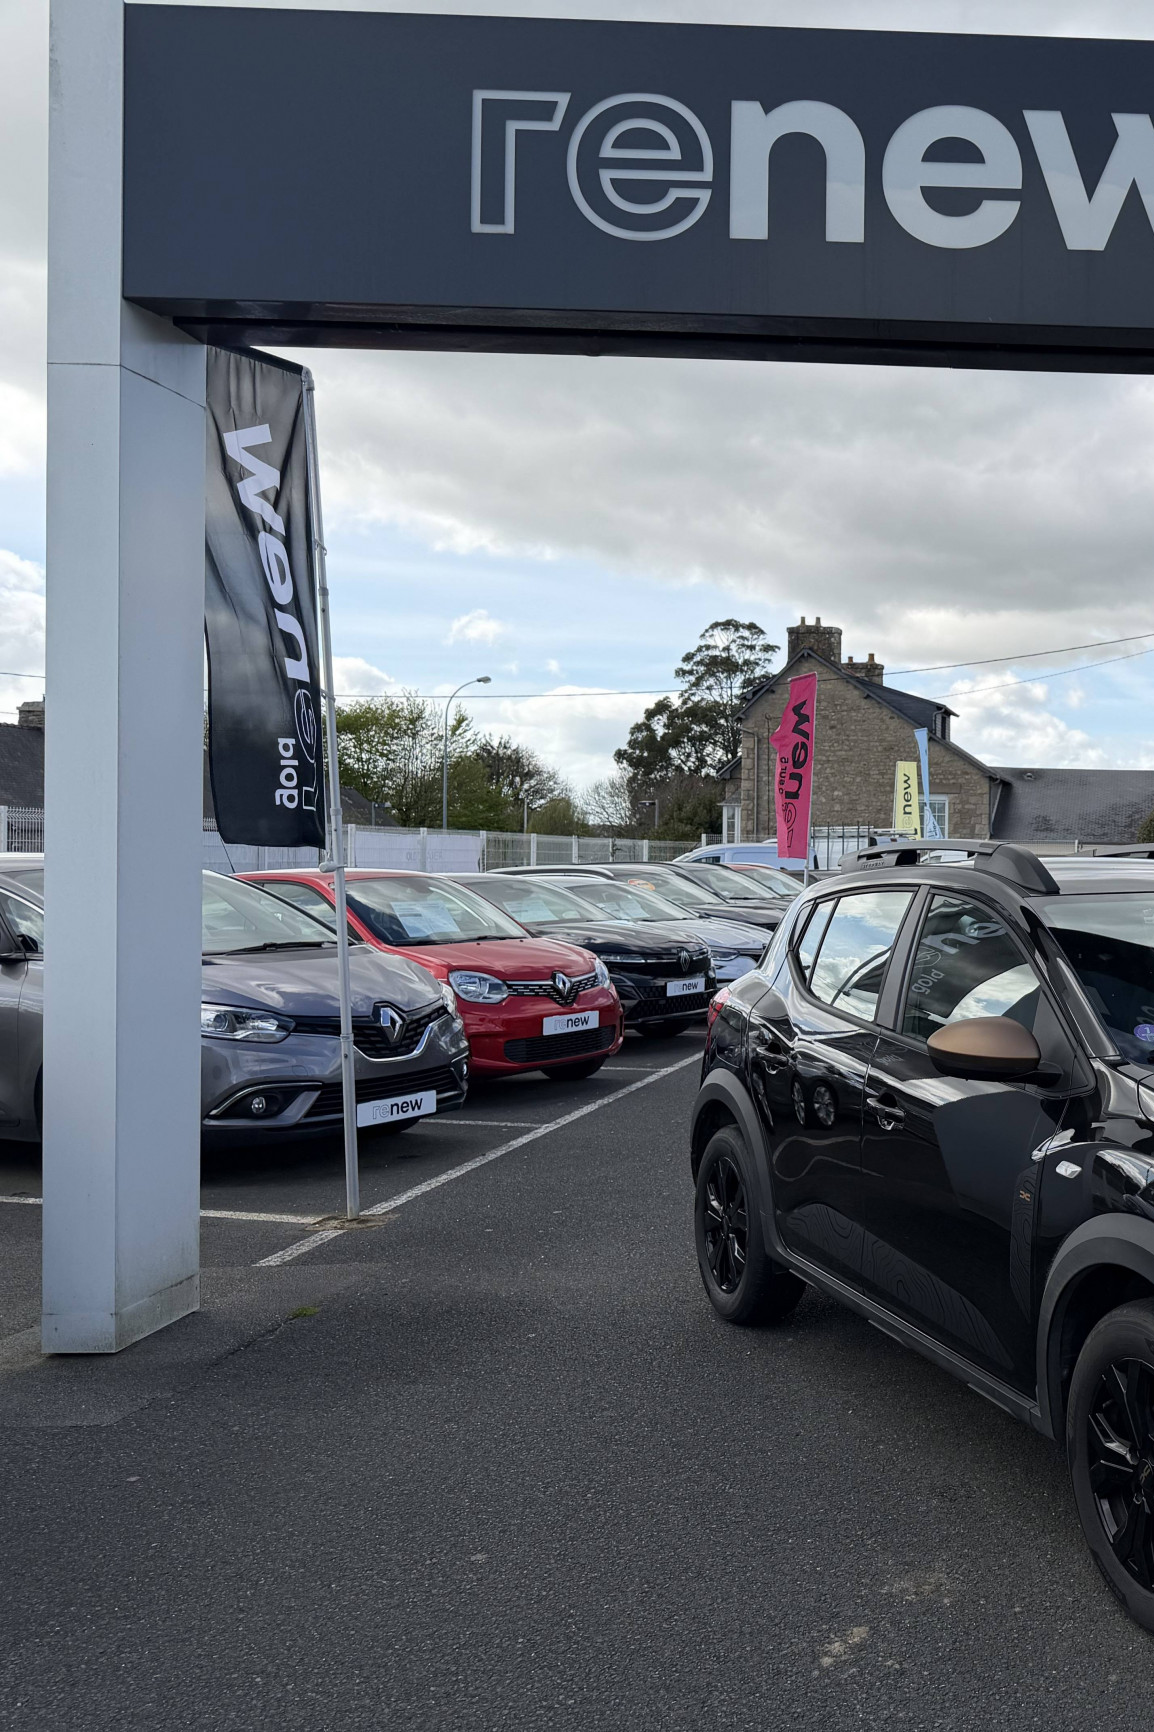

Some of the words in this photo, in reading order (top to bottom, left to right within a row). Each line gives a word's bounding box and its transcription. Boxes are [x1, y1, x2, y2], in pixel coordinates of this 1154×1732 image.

[902, 773, 914, 828] enew
[554, 1015, 590, 1031] renew
[372, 1098, 423, 1119] renew
